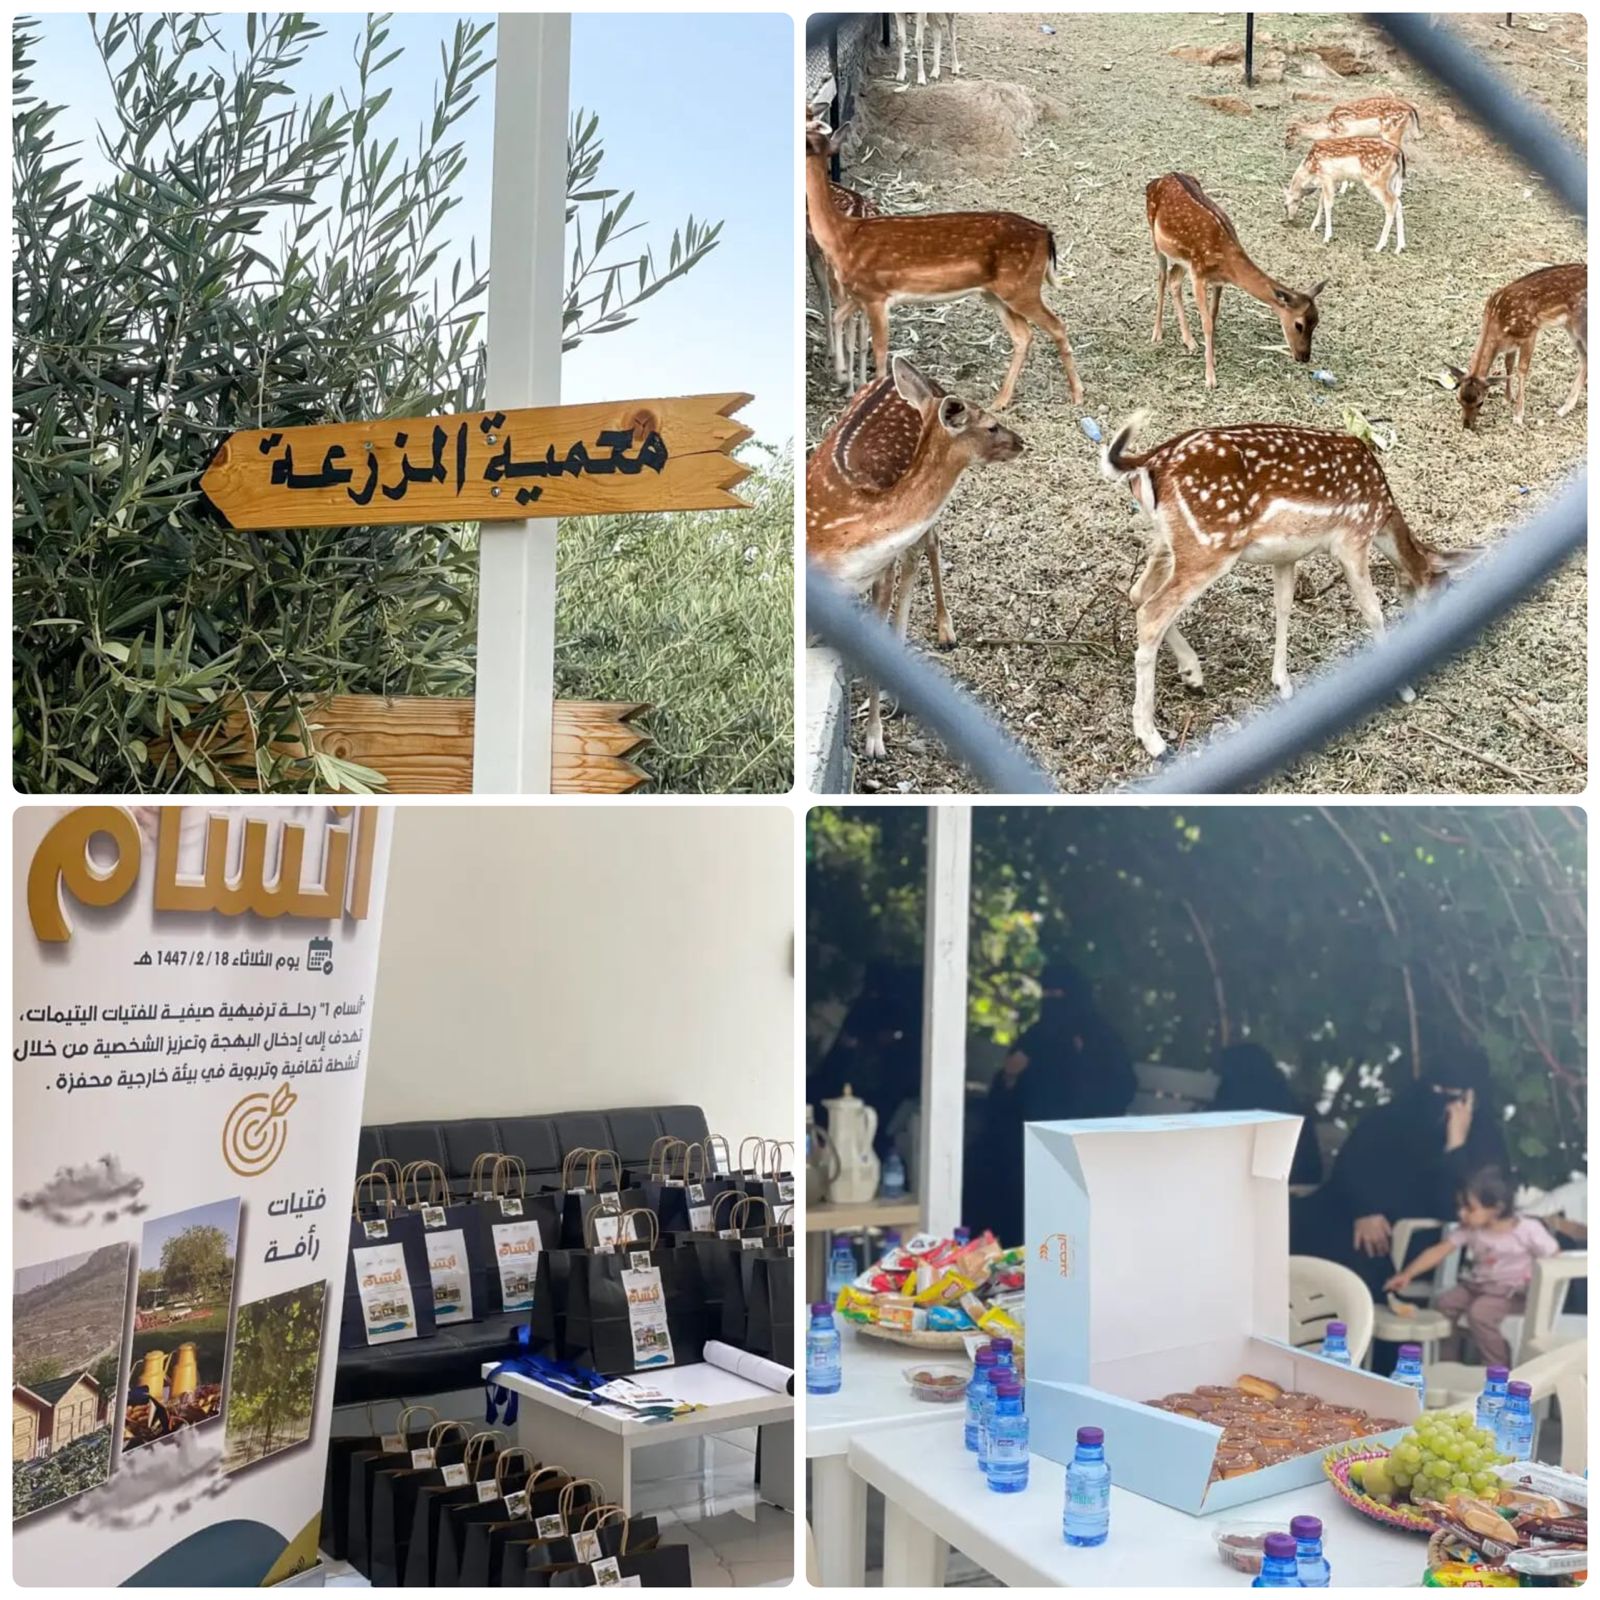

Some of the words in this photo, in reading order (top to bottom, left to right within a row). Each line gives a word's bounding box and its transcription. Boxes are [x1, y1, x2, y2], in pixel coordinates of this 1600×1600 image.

[259, 420, 467, 506] المزرعة
[482, 411, 669, 506] محمية
[232, 950, 273, 967] الثلاثاء
[276, 955, 300, 971] يوم
[19, 1005, 97, 1026] اليتيمات،
[102, 1004, 158, 1025] للفتيات
[219, 1002, 277, 1021] ترفيهية
[93, 1034, 164, 1058] الشخصية
[166, 1034, 207, 1055] وتعزيز
[210, 1032, 260, 1051] البهجة
[264, 1032, 303, 1052] إدخال
[305, 1031, 326, 1051] إلى
[328, 1028, 363, 1044] تهدف
[13, 1040, 57, 1061] خلال
[62, 1043, 89, 1058] من
[325, 1050, 361, 1072] أنشطة
[171, 1062, 198, 1084] بيئة
[201, 1063, 225, 1082] في
[229, 1062, 278, 1081] وتربوية
[281, 1057, 323, 1078] ثقافية
[56, 1072, 113, 1094] محفزة
[117, 1067, 169, 1090] خارجية
[268, 1187, 326, 1219] فتيات
